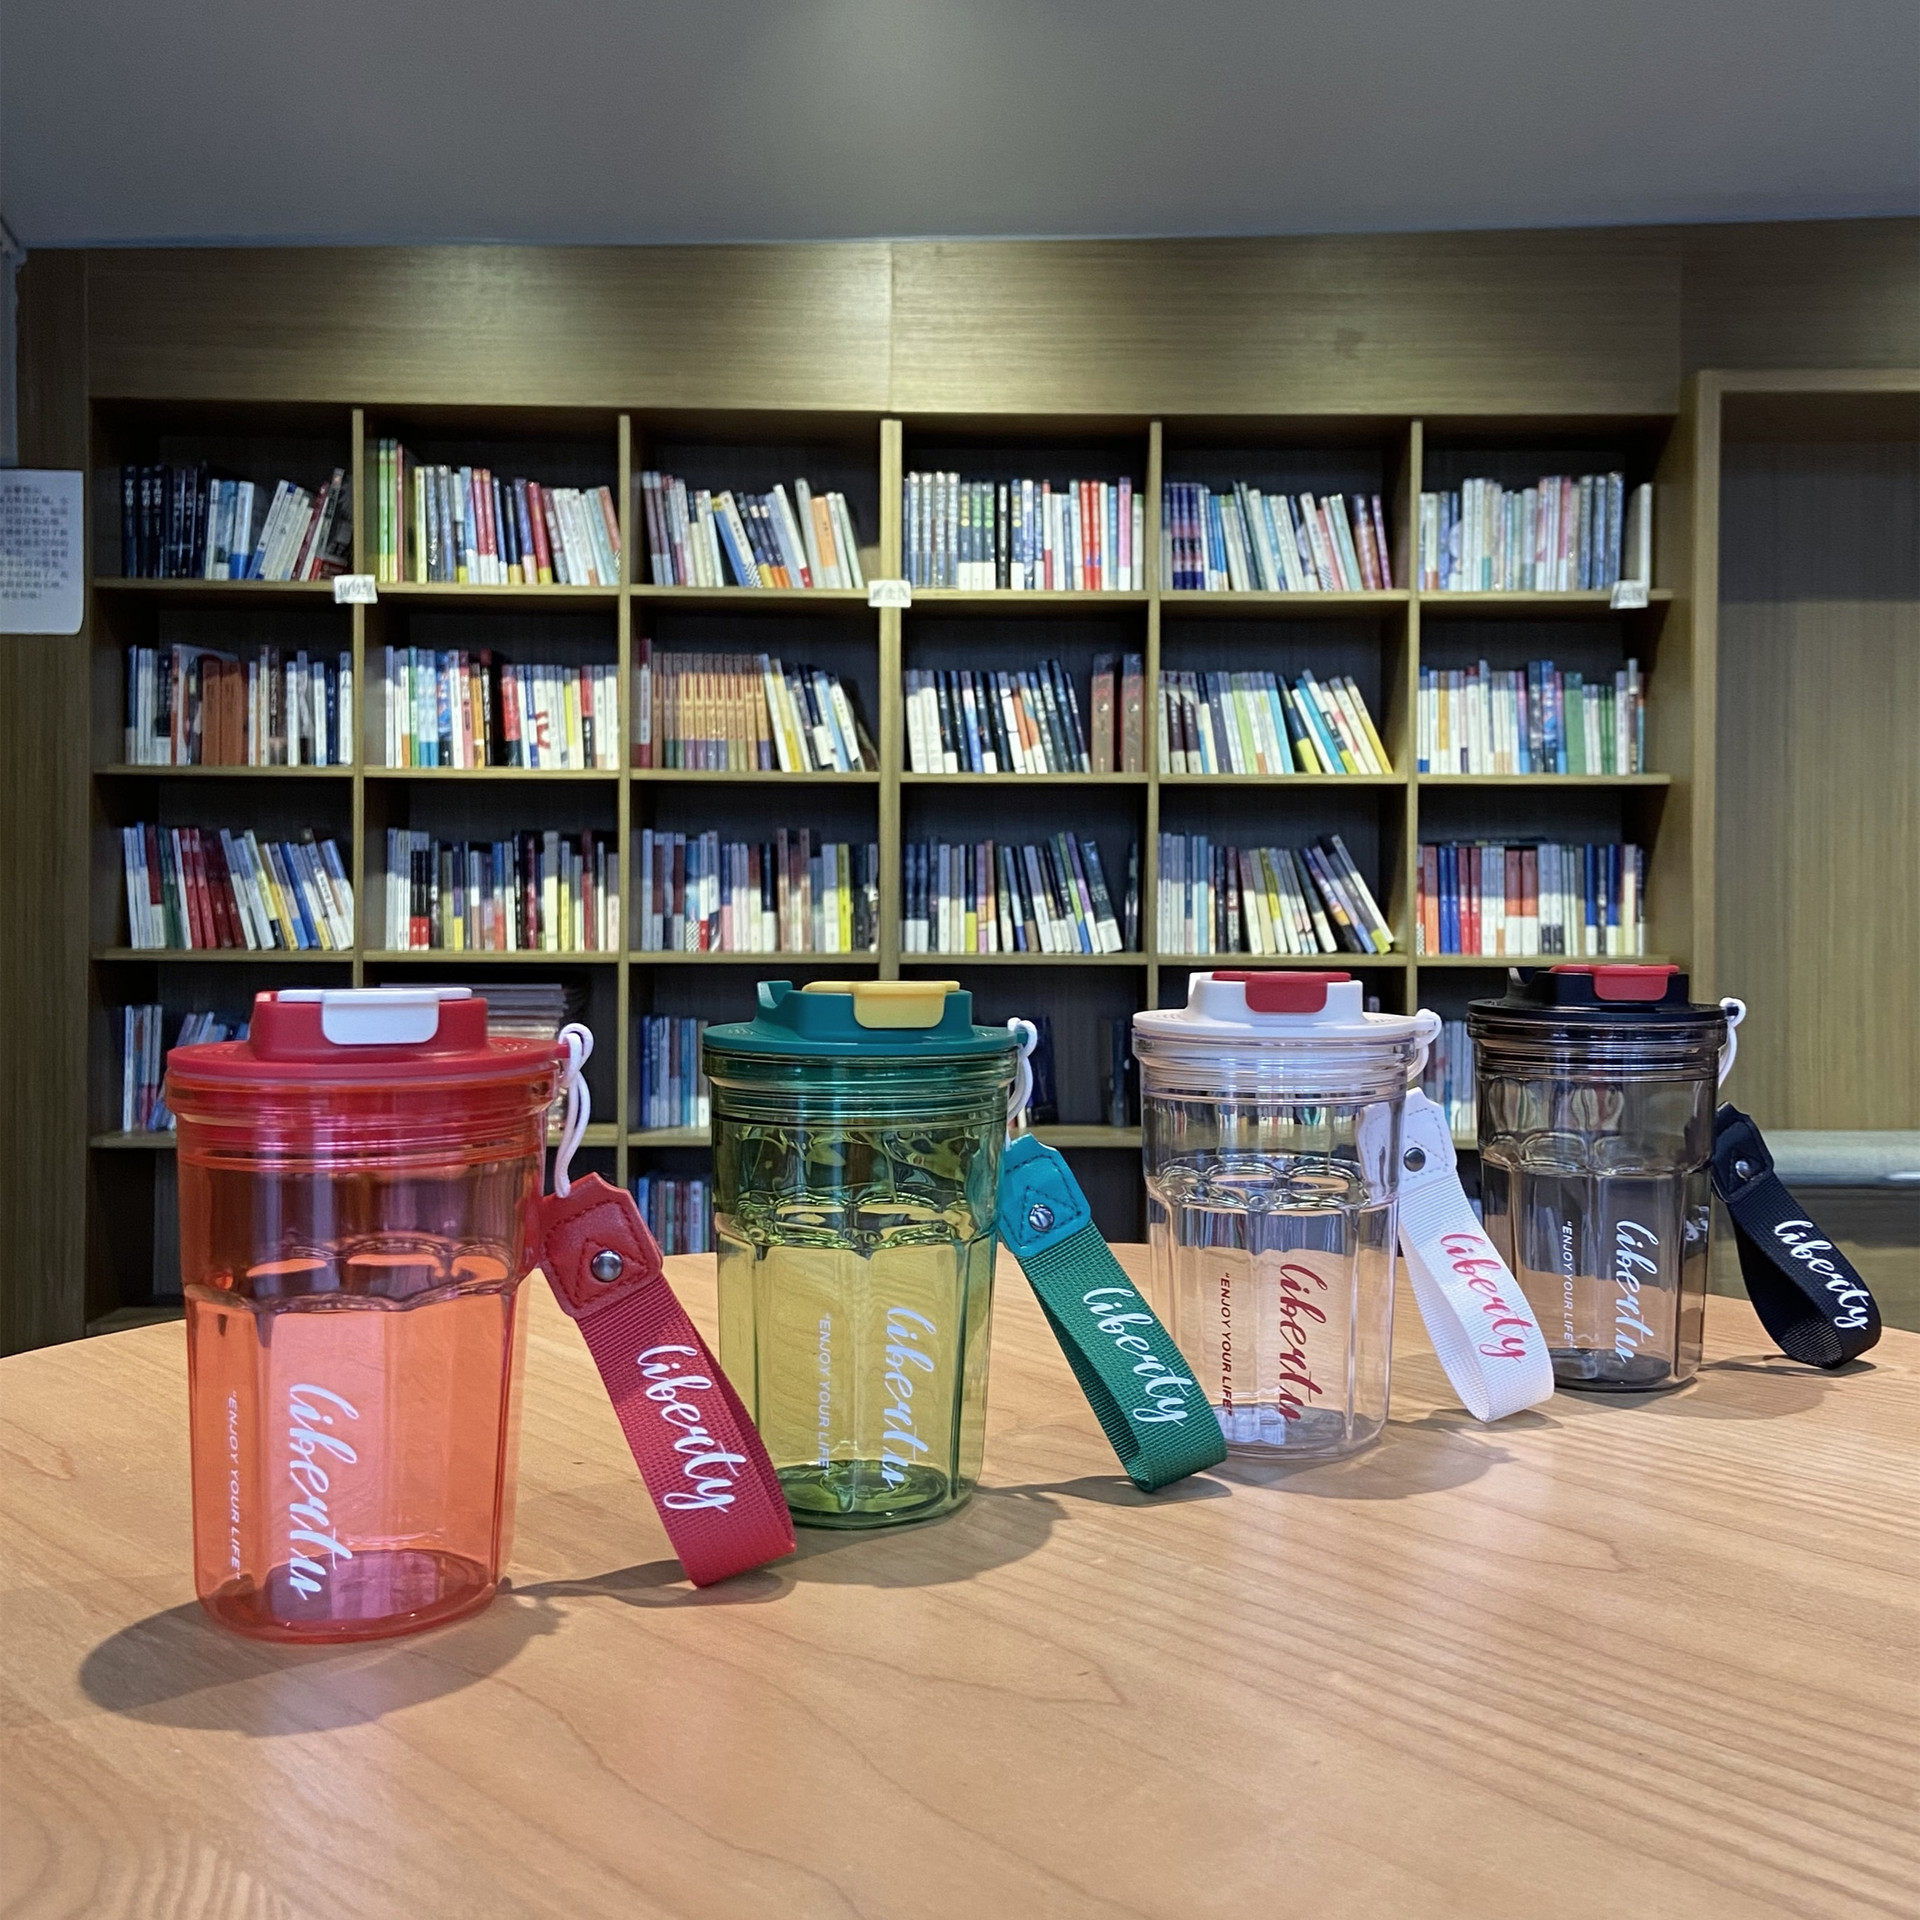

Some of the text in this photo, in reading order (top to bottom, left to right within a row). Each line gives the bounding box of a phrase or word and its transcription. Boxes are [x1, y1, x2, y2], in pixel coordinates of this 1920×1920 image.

[1563, 1274, 1573, 1310] YOUR
[1221, 1332, 1231, 1372] YOUR
[819, 1381, 830, 1427] YOUR
[230, 1469, 240, 1523] YOUR
